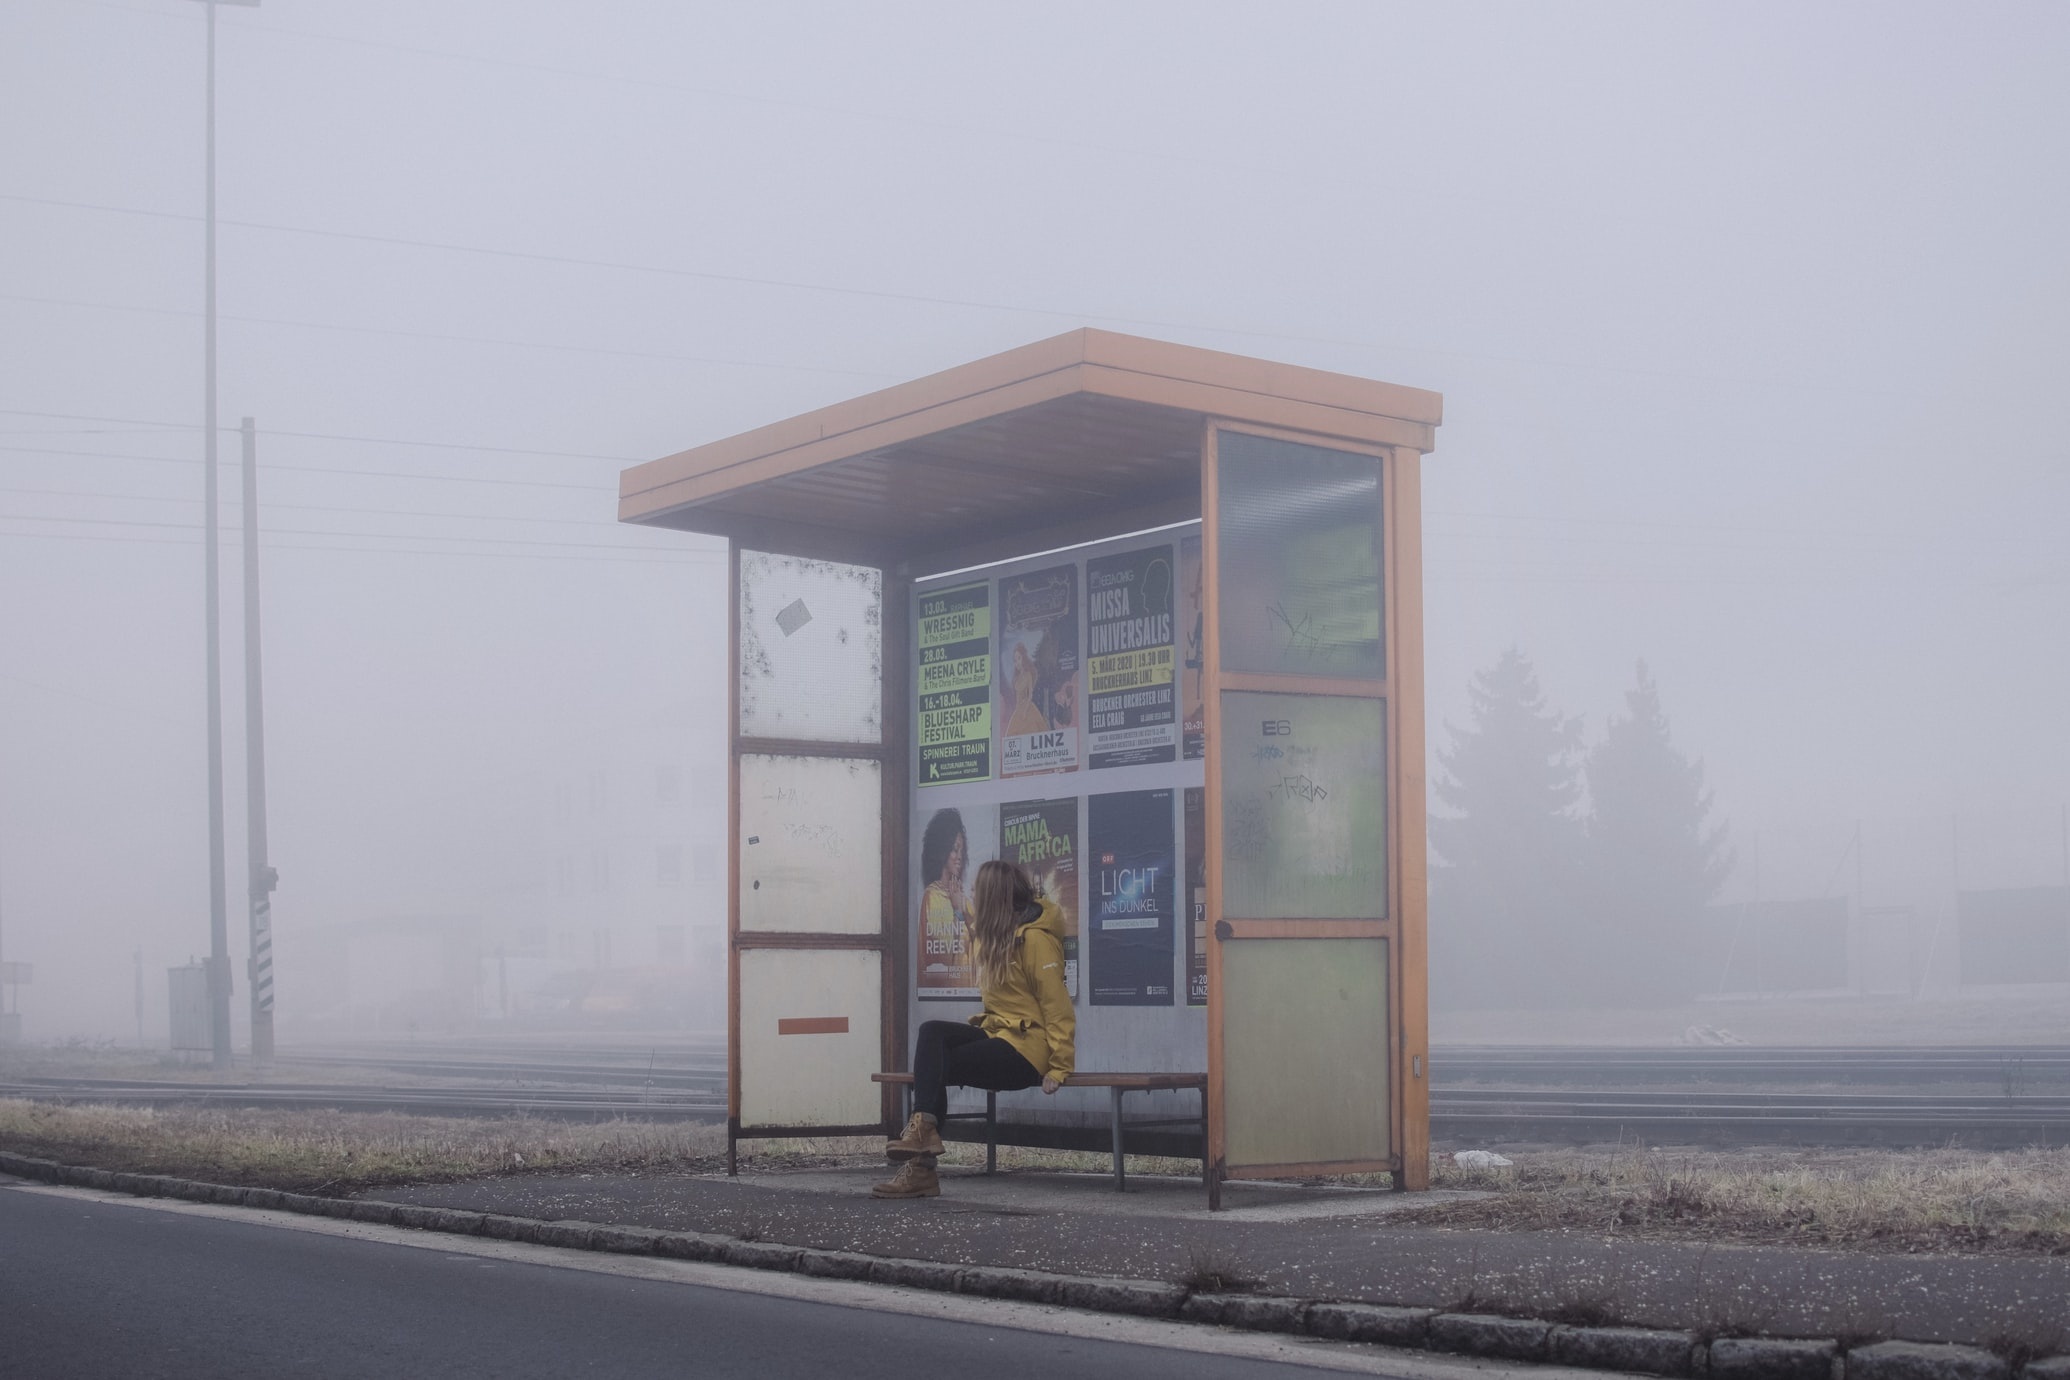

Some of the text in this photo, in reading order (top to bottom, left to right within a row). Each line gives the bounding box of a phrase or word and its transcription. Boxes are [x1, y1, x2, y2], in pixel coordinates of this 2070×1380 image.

[924, 600, 947, 616] 13.03.
[1091, 588, 1130, 622] MISSA
[924, 612, 974, 634] WRESSNIG
[1092, 613, 1170, 654] UNIVERSALIS
[924, 648, 947, 662] 28.03.
[924, 658, 985, 680] MEENA CRYLE
[1092, 669, 1152, 691] BRUCKNERHAUS LINZ
[924, 693, 962, 710] 16.-18.04.
[1092, 689, 1170, 713] BRUCKNER ORCHESTER LINZ
[924, 706, 982, 728] BLUESHARP
[1093, 711, 1125, 728] EELA CRAIG
[924, 725, 965, 743] FESTIVAL
[1262, 720, 1291, 736] E6
[1031, 732, 1064, 750] LINZ
[923, 743, 985, 760] SPINNEREI TRAUN
[1026, 748, 1069, 760] Brucknerhaus
[1004, 818, 1049, 847] MAMA
[1018, 834, 1072, 864] AFRICA
[1101, 868, 1158, 896] LICHT
[1102, 899, 1159, 914] INS DUNKEL
[927, 921, 966, 936] DIANNE
[927, 940, 965, 954] REEVES
[1192, 986, 1207, 995] LINZ
